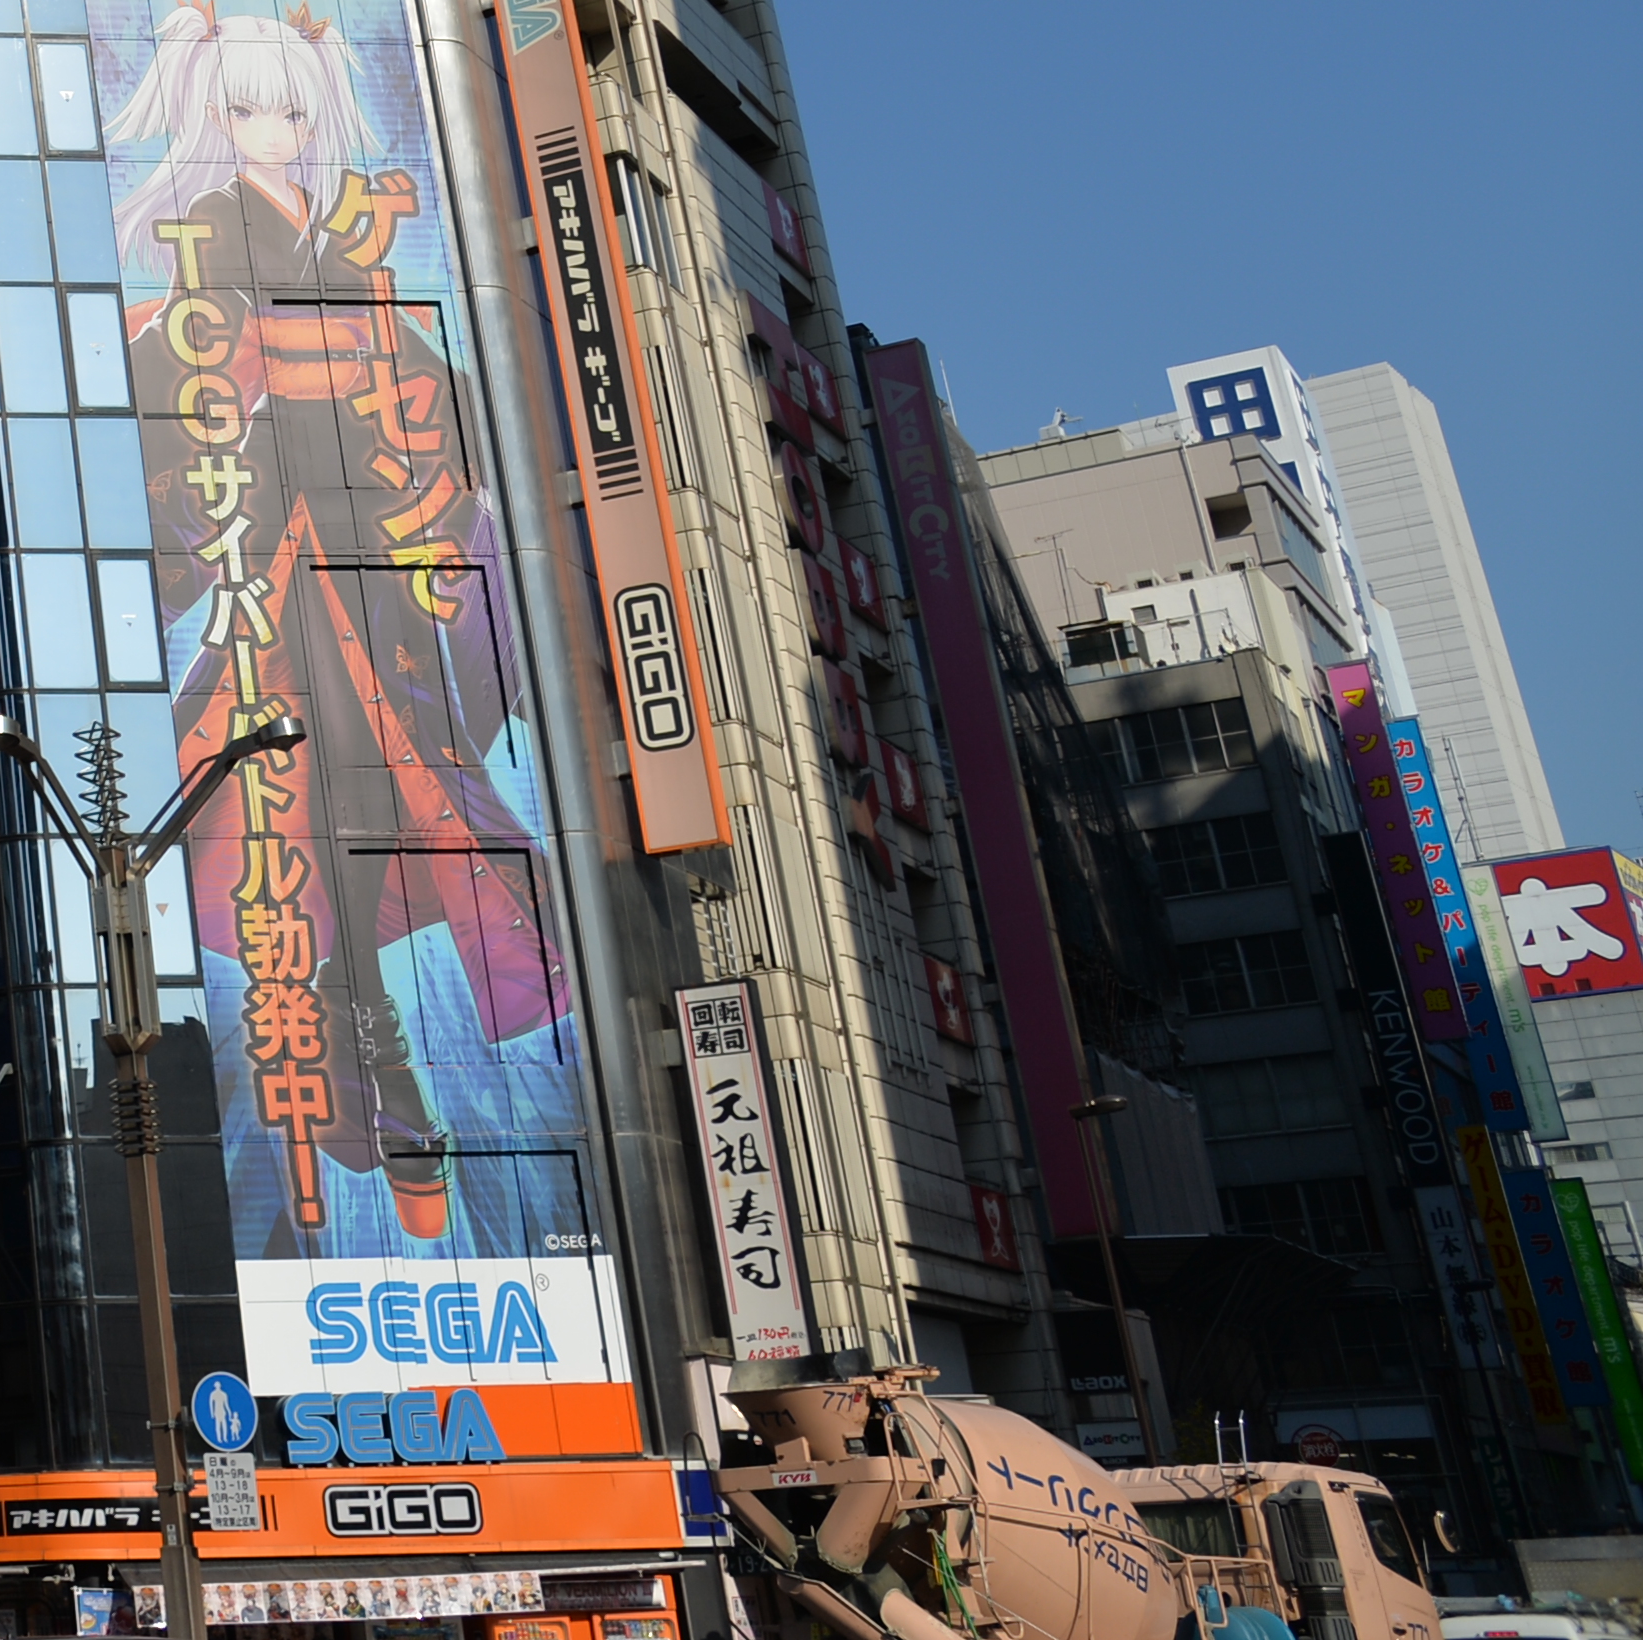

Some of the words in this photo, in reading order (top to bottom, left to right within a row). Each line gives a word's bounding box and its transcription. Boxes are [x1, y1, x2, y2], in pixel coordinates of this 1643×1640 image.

[551, 178, 602, 334] アキハバラ
[583, 347, 623, 443] ギーゴ
[323, 168, 465, 623] ゲーセンで
[690, 1000, 741, 1028] 回転
[695, 1028, 746, 1054] 寿司
[1367, 988, 1439, 1165] KENWOOD
[705, 1077, 782, 1291] 元祖寿司
[305, 1280, 559, 1366] SEGA
[822, 1391, 854, 1412] 771
[284, 1387, 507, 1465] SEGA
[752, 1410, 796, 1427] 771
[1304, 1444, 1336, 1458] 消火栓
[777, 1472, 812, 1484] KYB
[8, 1506, 140, 1530] アキハバラ
